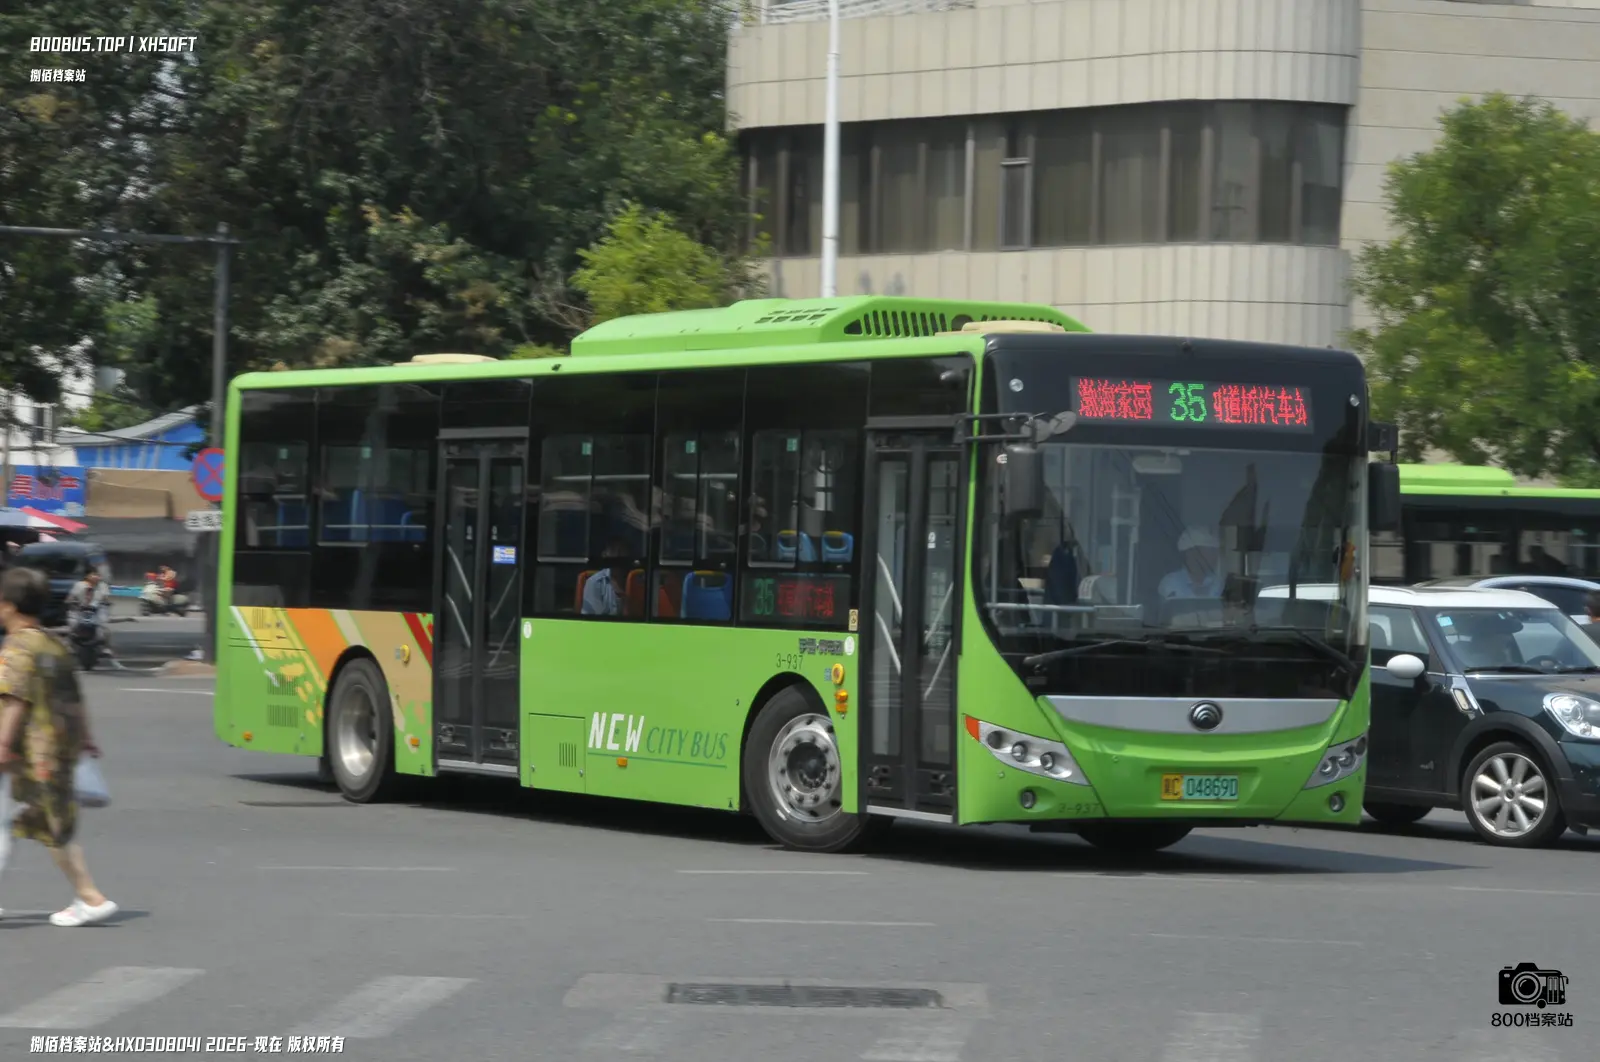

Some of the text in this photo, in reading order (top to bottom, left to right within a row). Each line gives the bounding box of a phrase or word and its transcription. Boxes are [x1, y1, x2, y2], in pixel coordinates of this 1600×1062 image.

[1168, 382, 1208, 422] 35
[752, 577, 775, 615] 35
[776, 653, 804, 670] 3-937
[588, 711, 729, 760] NEW CITY BUS
